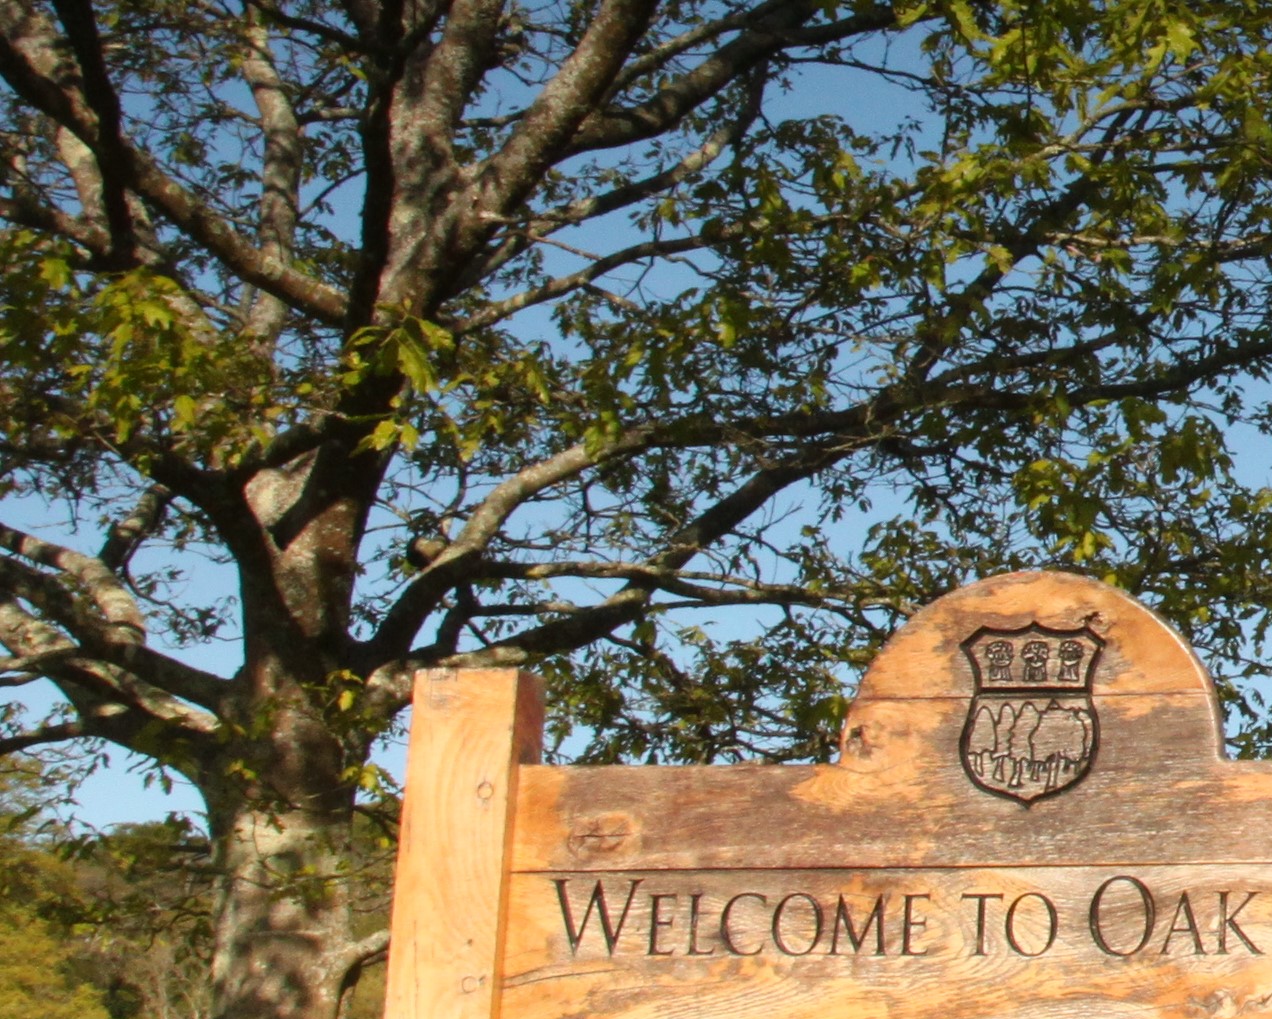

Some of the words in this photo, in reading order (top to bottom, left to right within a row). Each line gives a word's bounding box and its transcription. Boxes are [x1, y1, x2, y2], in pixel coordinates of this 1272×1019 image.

[552, 877, 931, 957] WELCOME
[961, 891, 1058, 958] TO
[1088, 874, 1266, 958] OAK
